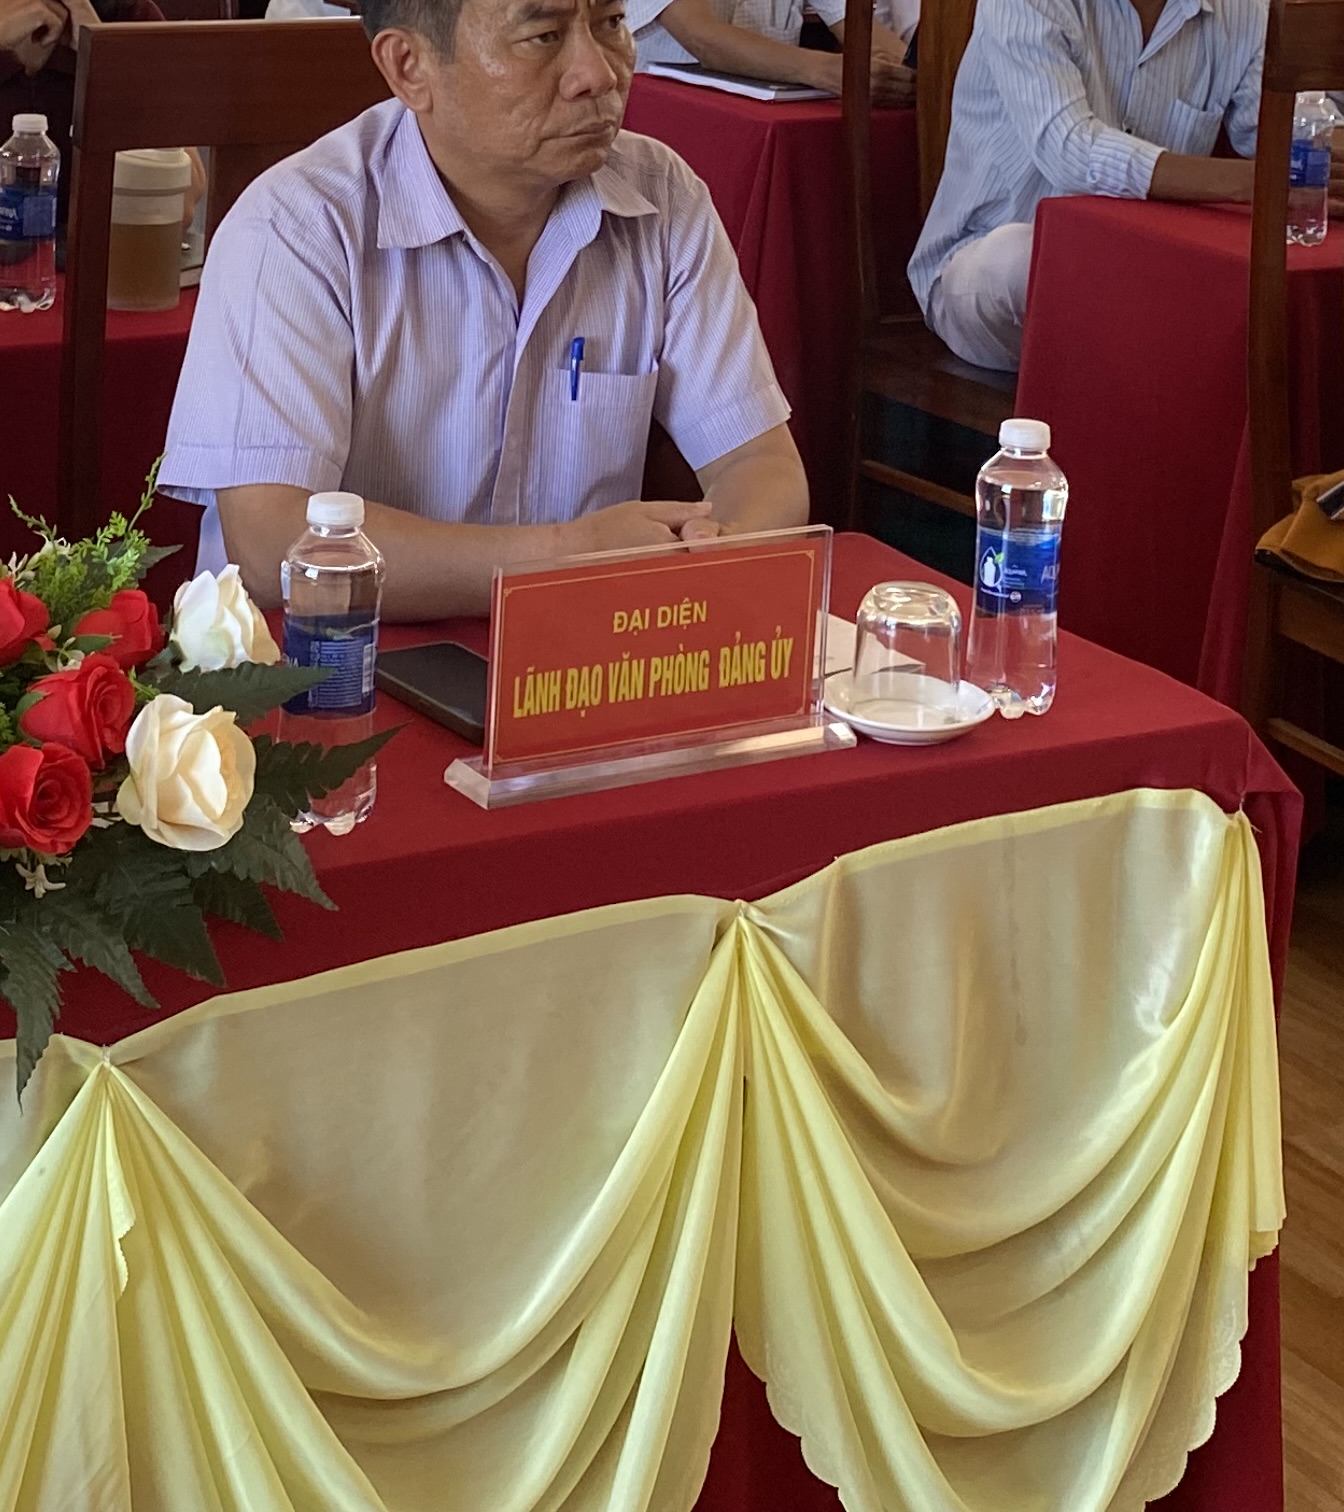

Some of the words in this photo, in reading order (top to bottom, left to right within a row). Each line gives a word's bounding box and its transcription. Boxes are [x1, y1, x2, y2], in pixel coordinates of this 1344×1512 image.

[613, 608, 650, 636] ĐẠI
[657, 597, 707, 630] DIỆN
[513, 665, 561, 719] LÃNH
[565, 664, 603, 718] ĐẠO
[608, 651, 645, 704] VĂN
[649, 643, 710, 698] PHÒNG
[718, 631, 765, 688] ĐẢNG
[770, 625, 794, 680] ỦY
